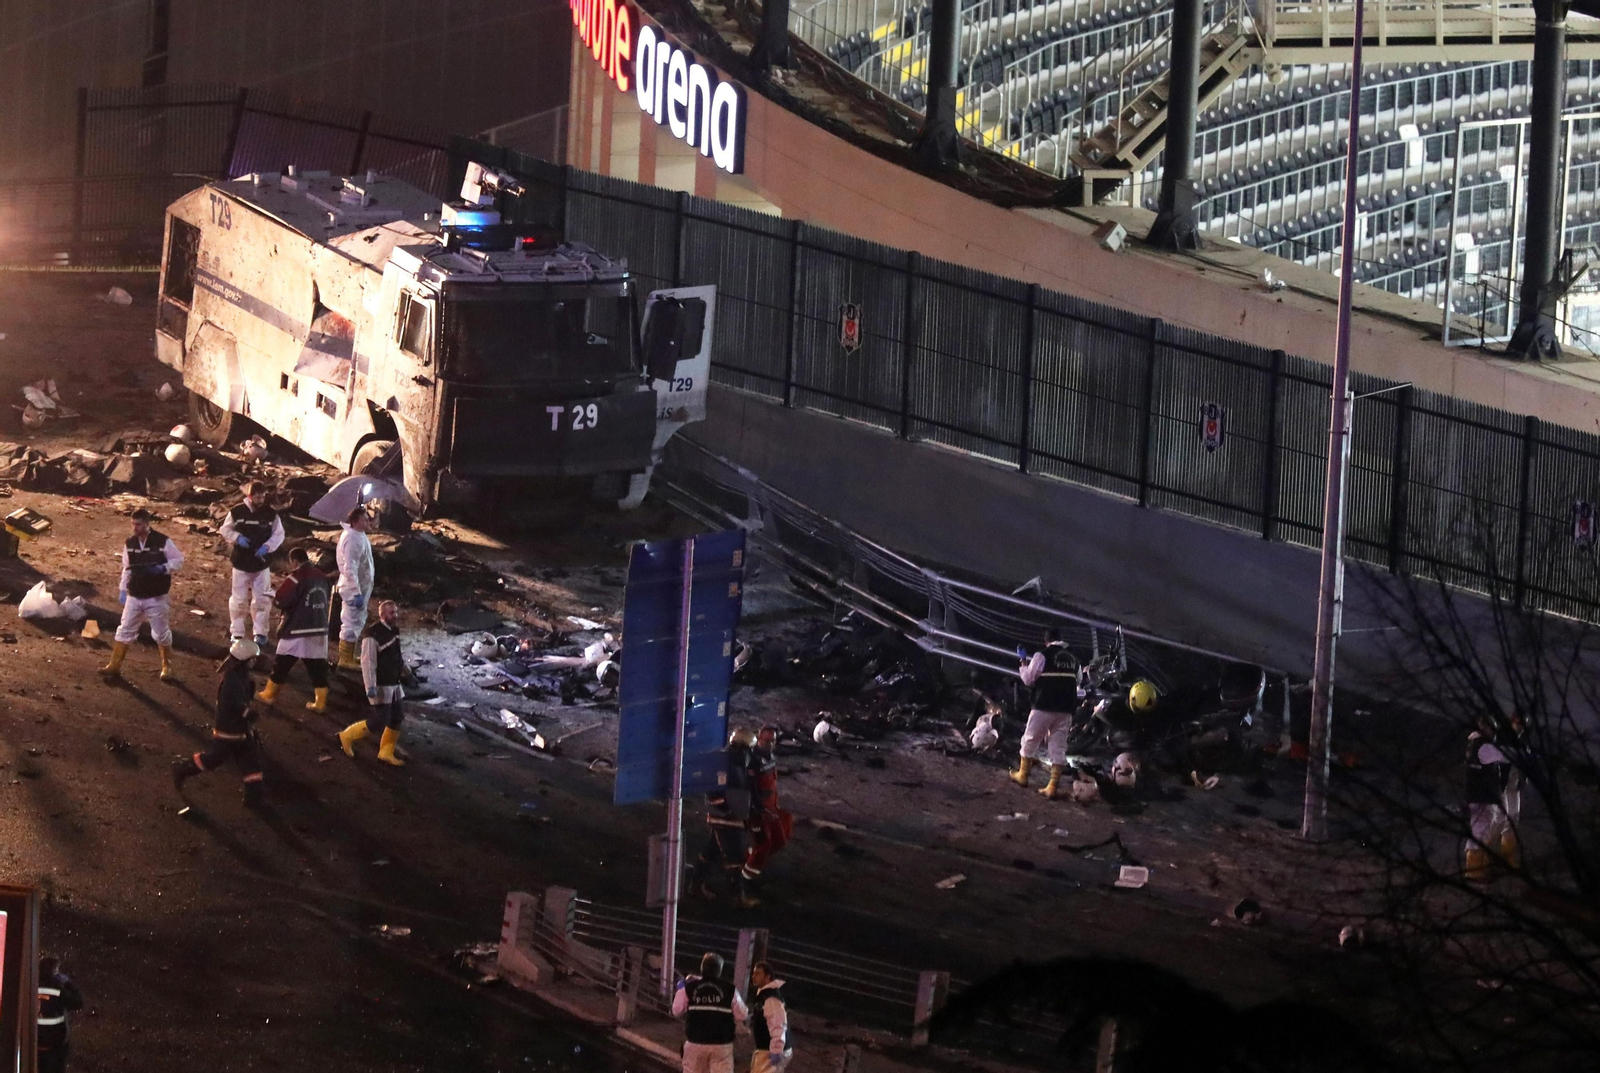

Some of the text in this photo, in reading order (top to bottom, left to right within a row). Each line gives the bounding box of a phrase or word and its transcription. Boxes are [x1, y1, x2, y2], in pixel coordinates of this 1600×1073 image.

[636, 25, 738, 174] arena
[210, 193, 232, 231] T29
[669, 377, 693, 393] T29
[546, 404, 598, 431] T 29
